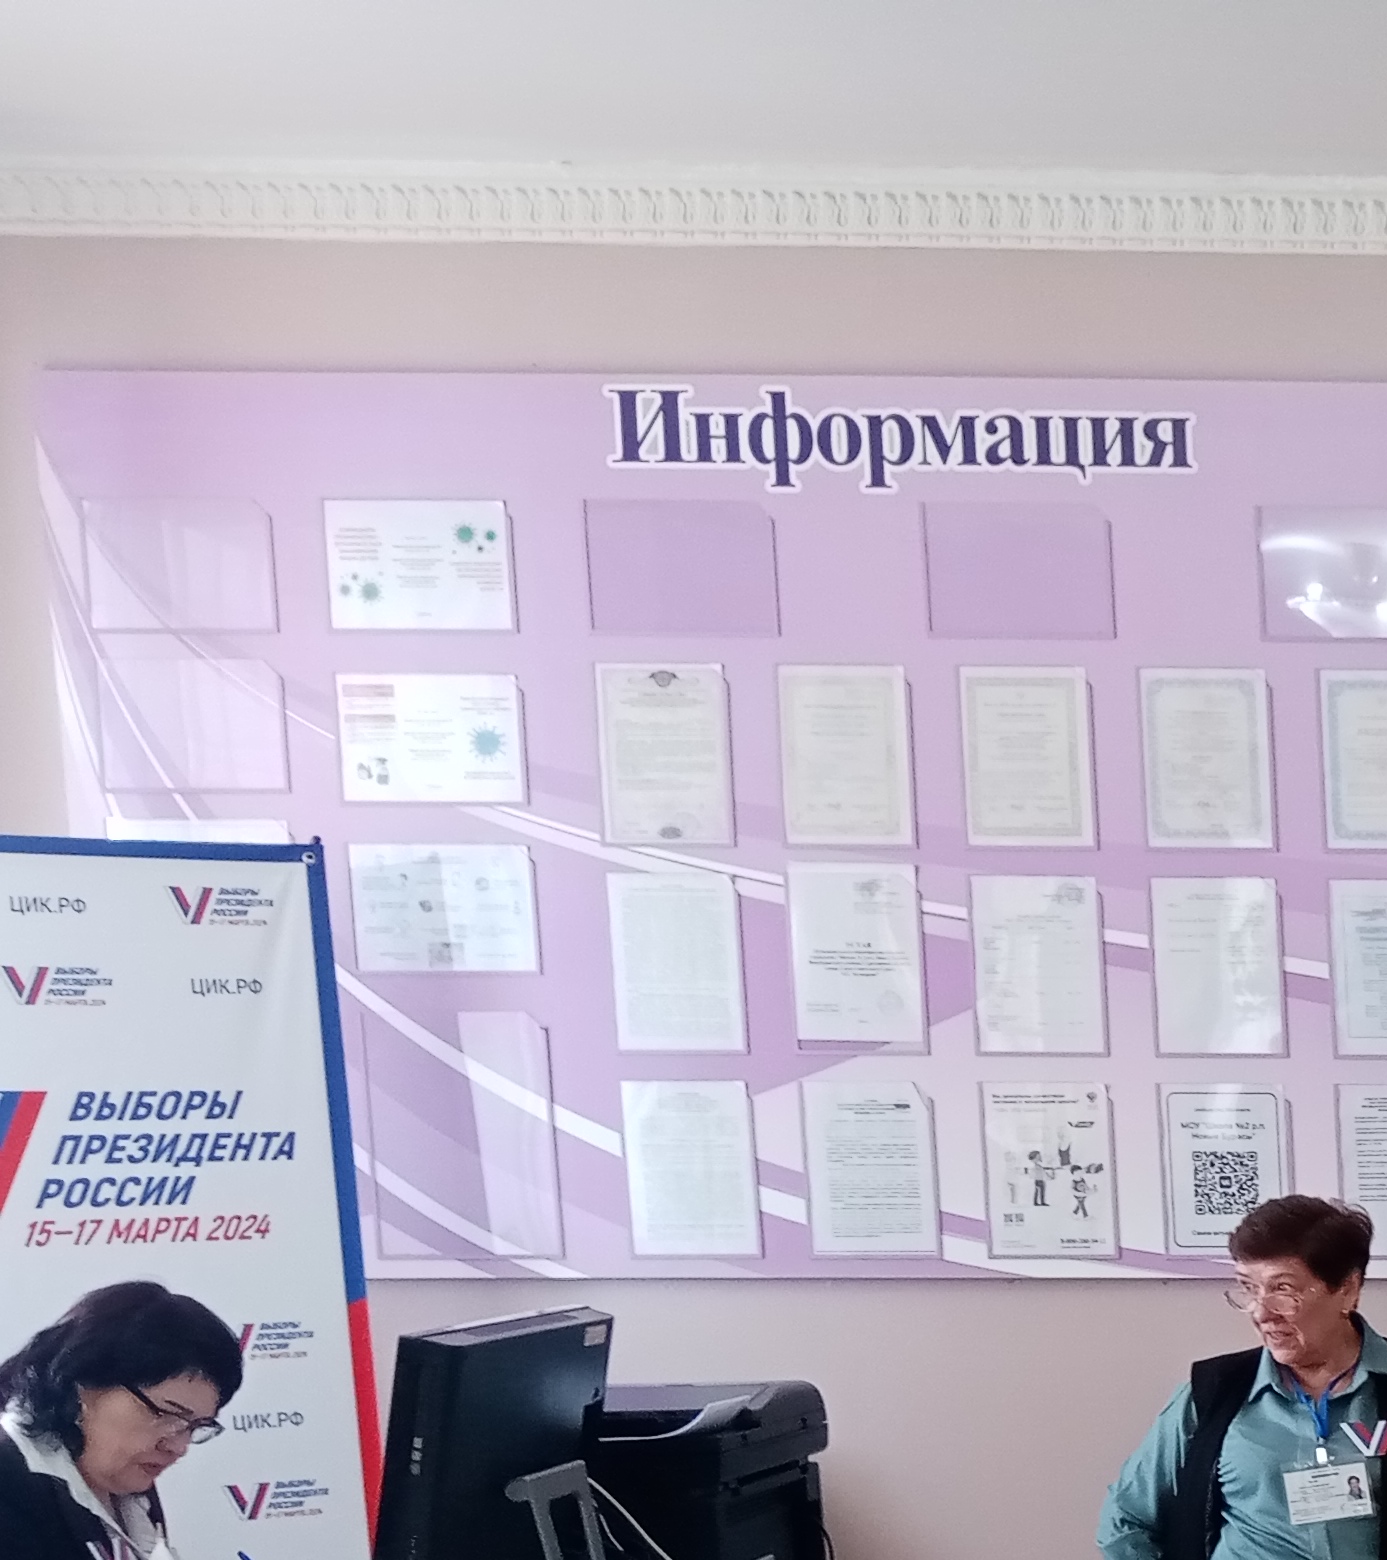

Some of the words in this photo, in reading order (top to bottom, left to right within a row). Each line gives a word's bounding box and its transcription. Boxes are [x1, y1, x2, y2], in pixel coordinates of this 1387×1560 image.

[609, 389, 1194, 488] Информация
[10, 896, 87, 915] ЦИК.РФ
[190, 977, 264, 996] ЦИК.РФ
[68, 1090, 244, 1122] ВЫБОРЫ
[51, 1131, 296, 1168] ПРЕЗИДЕНТА
[35, 1175, 197, 1209] РОССИИ
[105, 1215, 200, 1245] МАРТА
[205, 1213, 272, 1241] 2024
[232, 1411, 304, 1432] ЦИК.РФ
